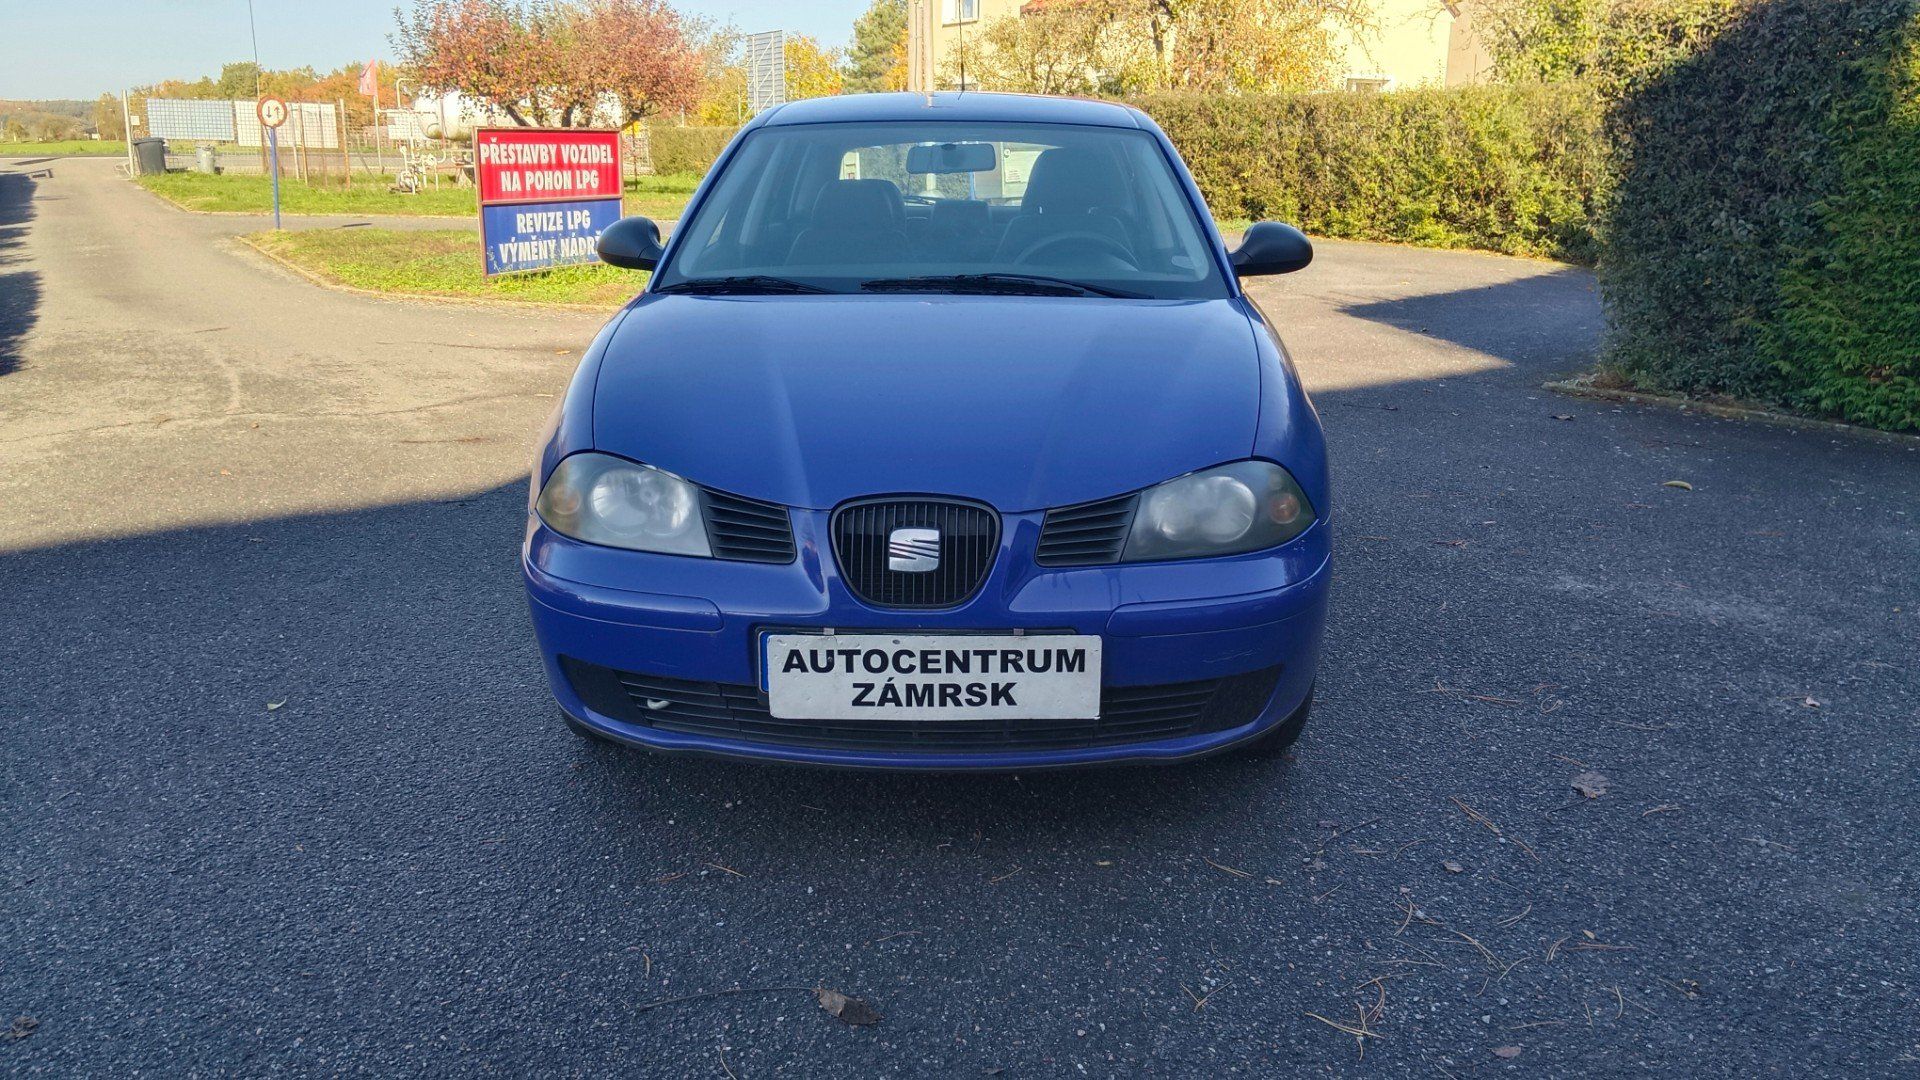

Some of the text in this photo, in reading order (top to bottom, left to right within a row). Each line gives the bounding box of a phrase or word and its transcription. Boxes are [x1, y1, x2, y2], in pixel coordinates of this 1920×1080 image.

[480, 137, 614, 165] PŘESTAVBY VOZIDEL
[501, 170, 599, 192] NA POHON LPG
[516, 210, 591, 234] REVIZE LPG
[499, 236, 556, 264] VÝMĚNY
[782, 649, 1086, 674] AUTOCENTRUM
[851, 677, 1018, 707] ZÁMRSK
